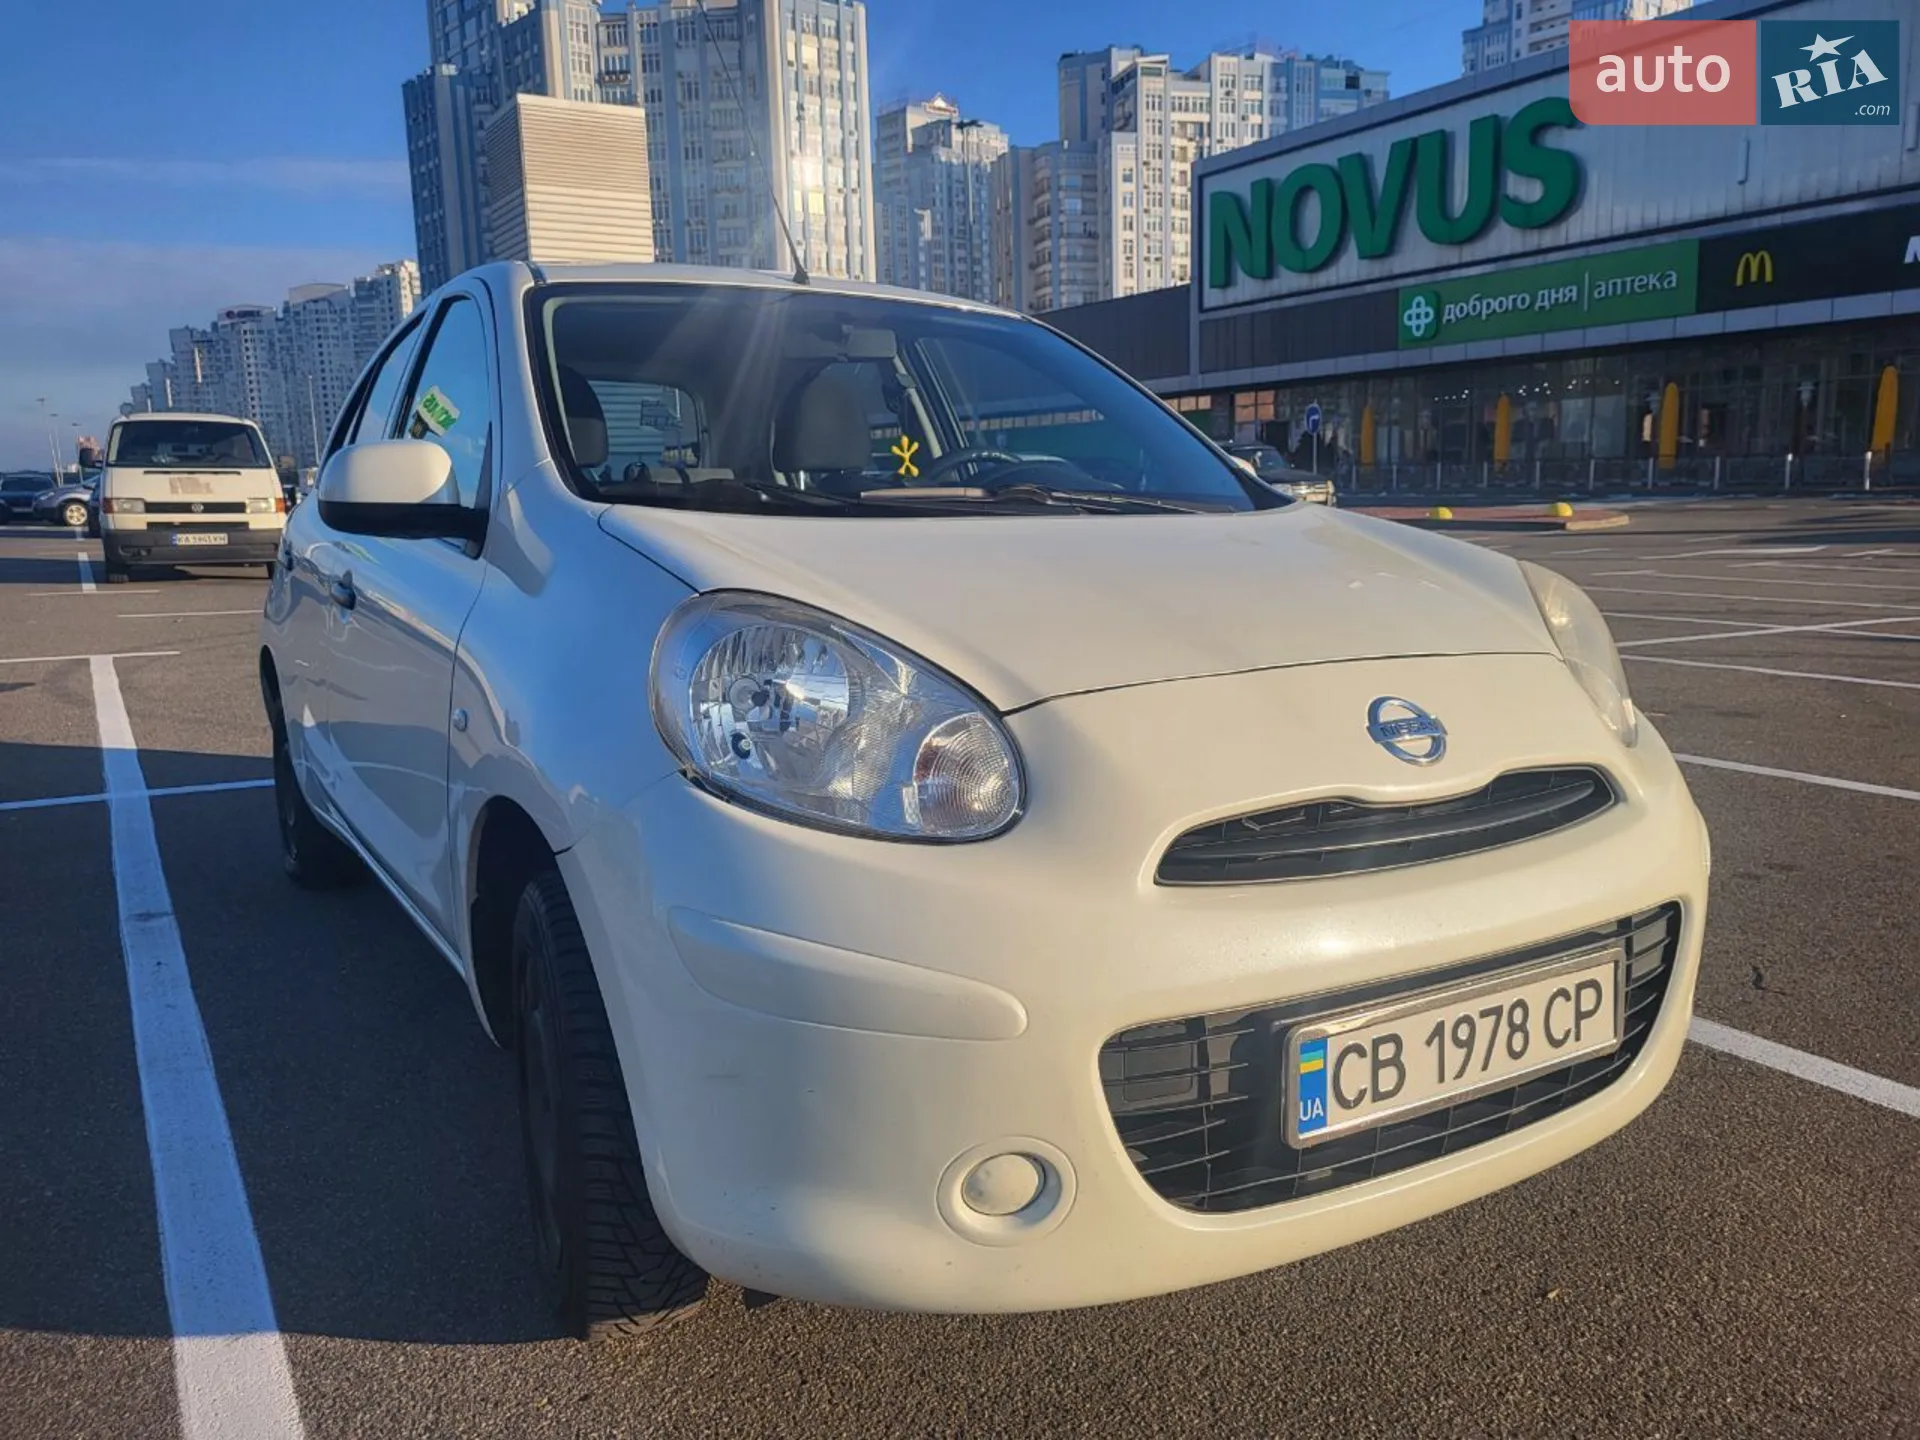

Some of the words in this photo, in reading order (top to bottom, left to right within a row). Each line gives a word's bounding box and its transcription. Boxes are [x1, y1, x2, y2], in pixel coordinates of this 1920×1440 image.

[1209, 96, 1581, 289] NOVUS
[1442, 292, 1531, 324] доброго
[1534, 284, 1578, 312] дня
[1593, 269, 1678, 299] аптека
[1332, 1032, 1406, 1110] CB
[1425, 998, 1530, 1084] 1978
[1543, 978, 1603, 1049] CP
[1299, 1097, 1324, 1121] UA
